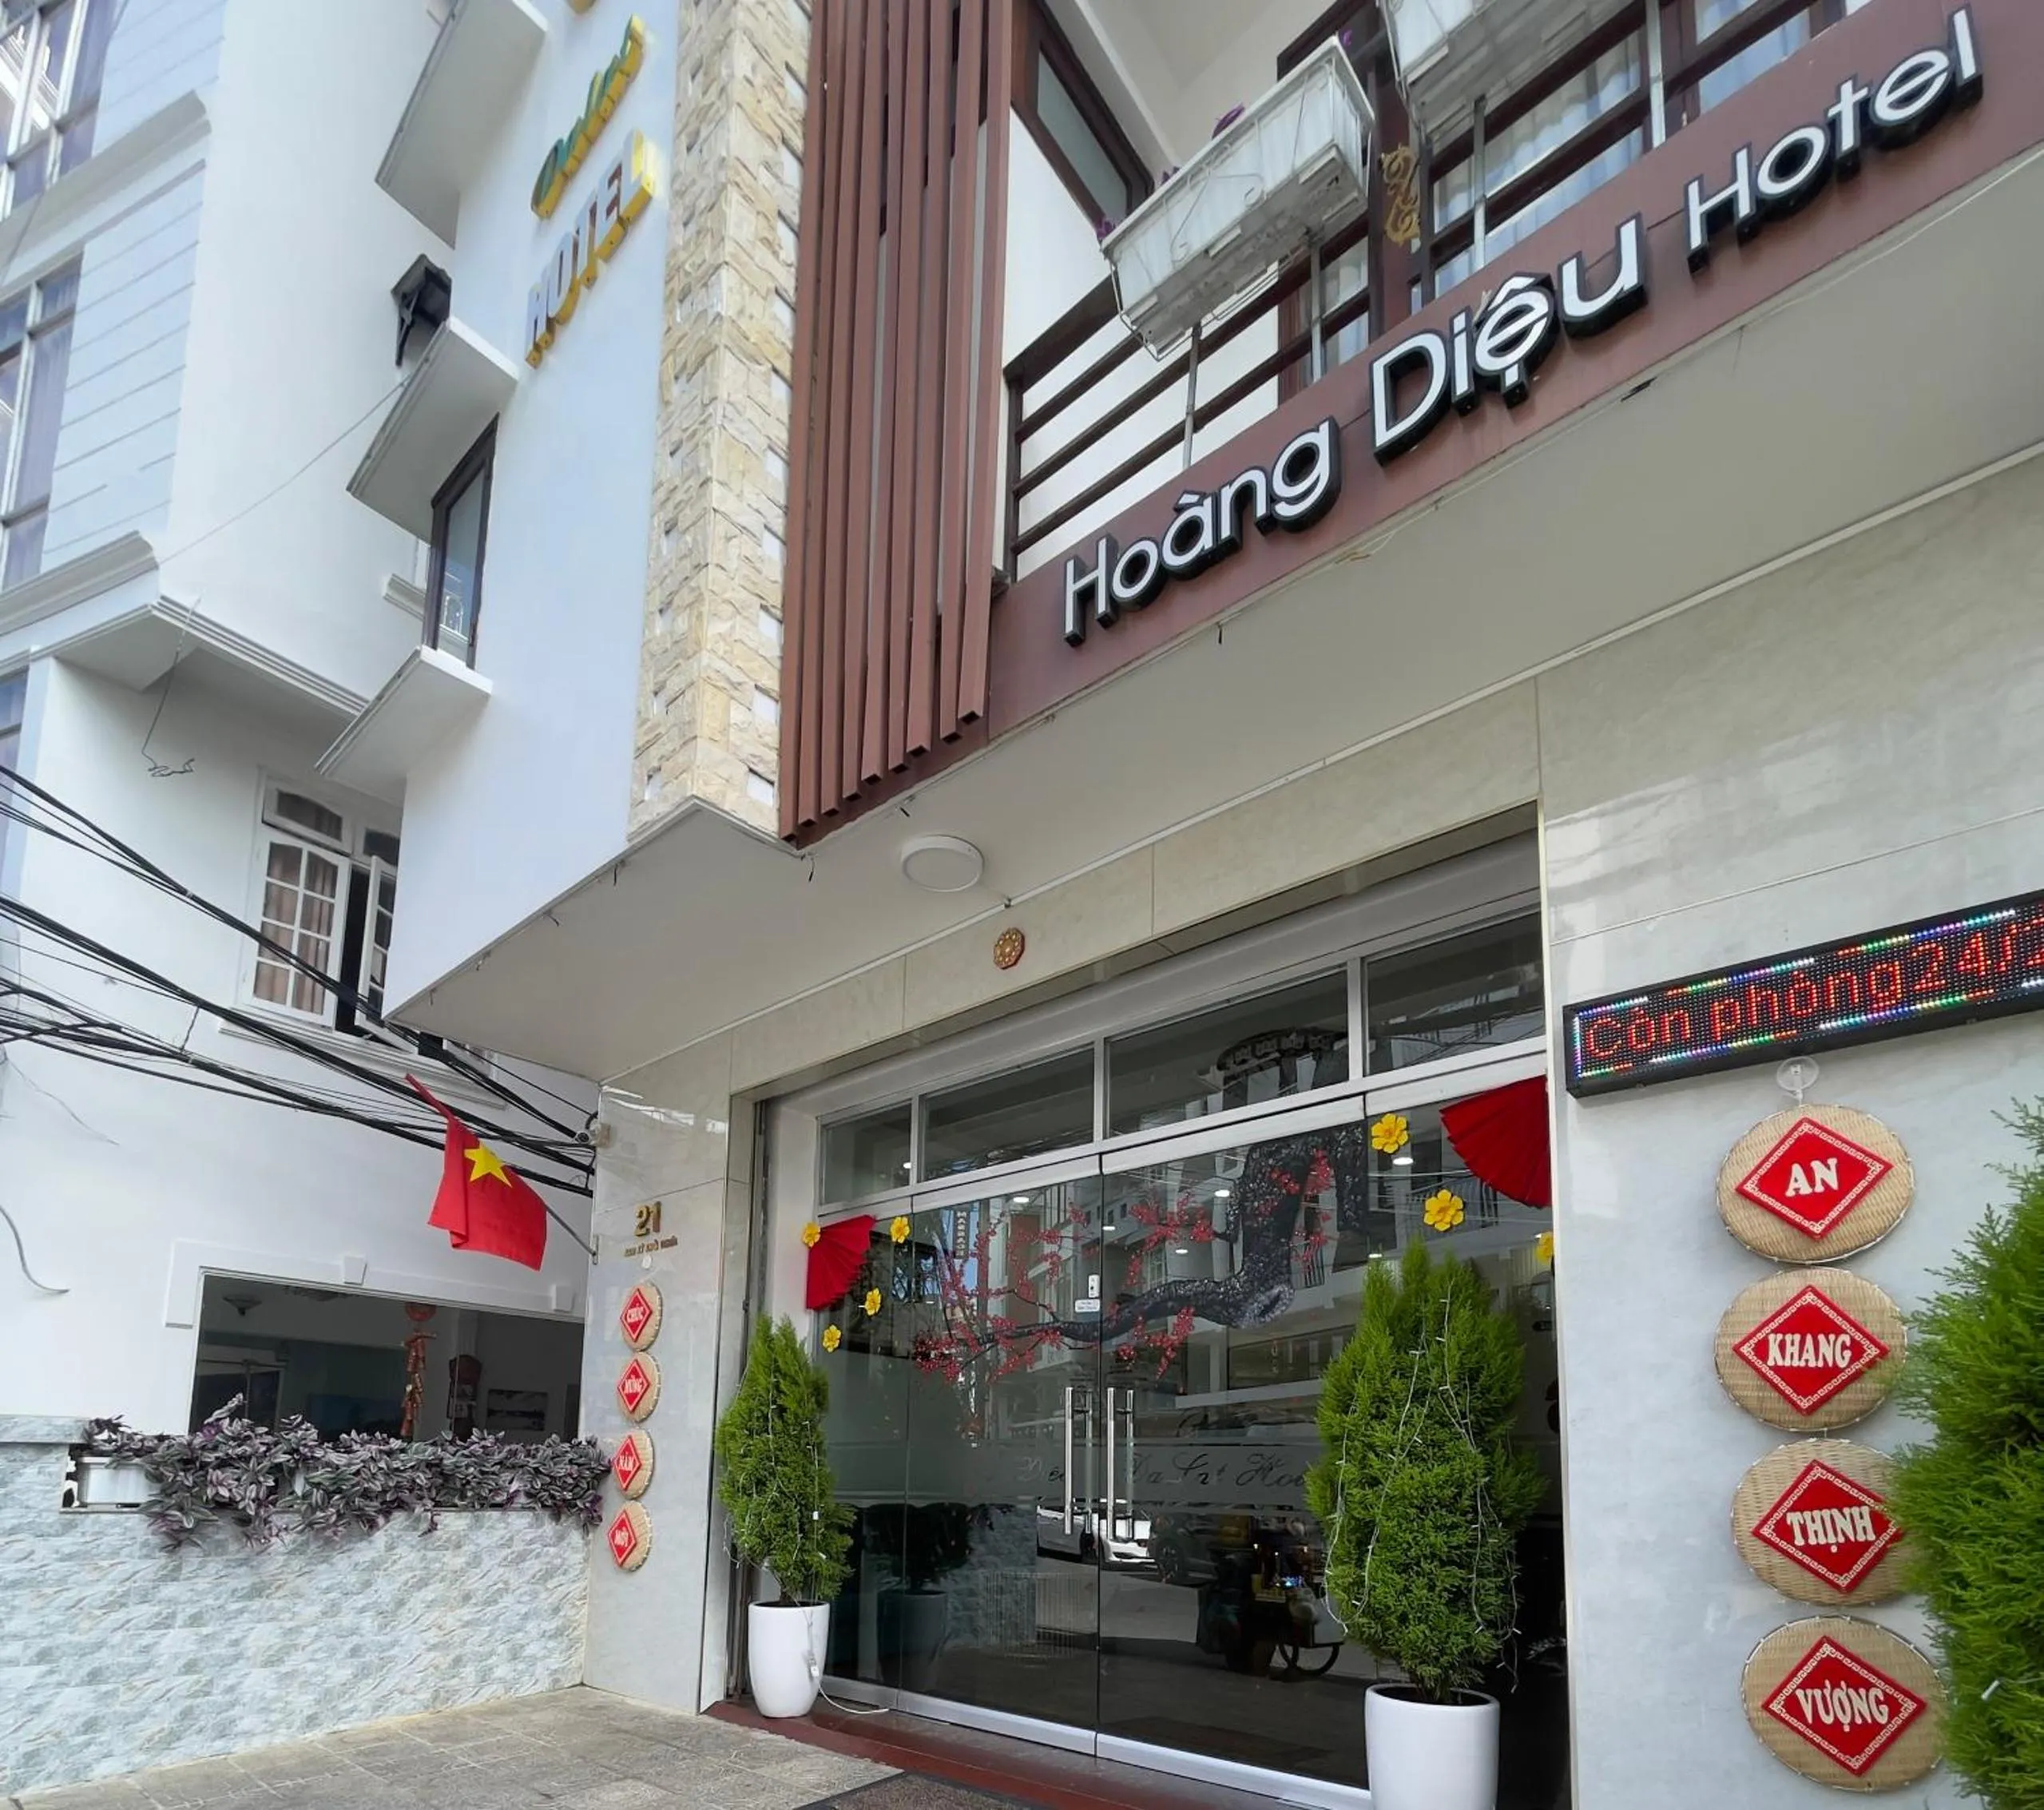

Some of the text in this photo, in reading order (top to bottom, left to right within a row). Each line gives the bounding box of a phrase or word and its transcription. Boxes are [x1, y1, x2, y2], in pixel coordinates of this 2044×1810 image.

[1065, 5, 1982, 645] Hoàng Diệu Hotel
[1785, 1157, 1838, 1197] AN
[634, 1201, 661, 1236] 21
[1767, 1333, 1852, 1368] KHANG
[1786, 1506, 1876, 1554] THỊNH
[1796, 1678, 1889, 1733] VƯỢNG
